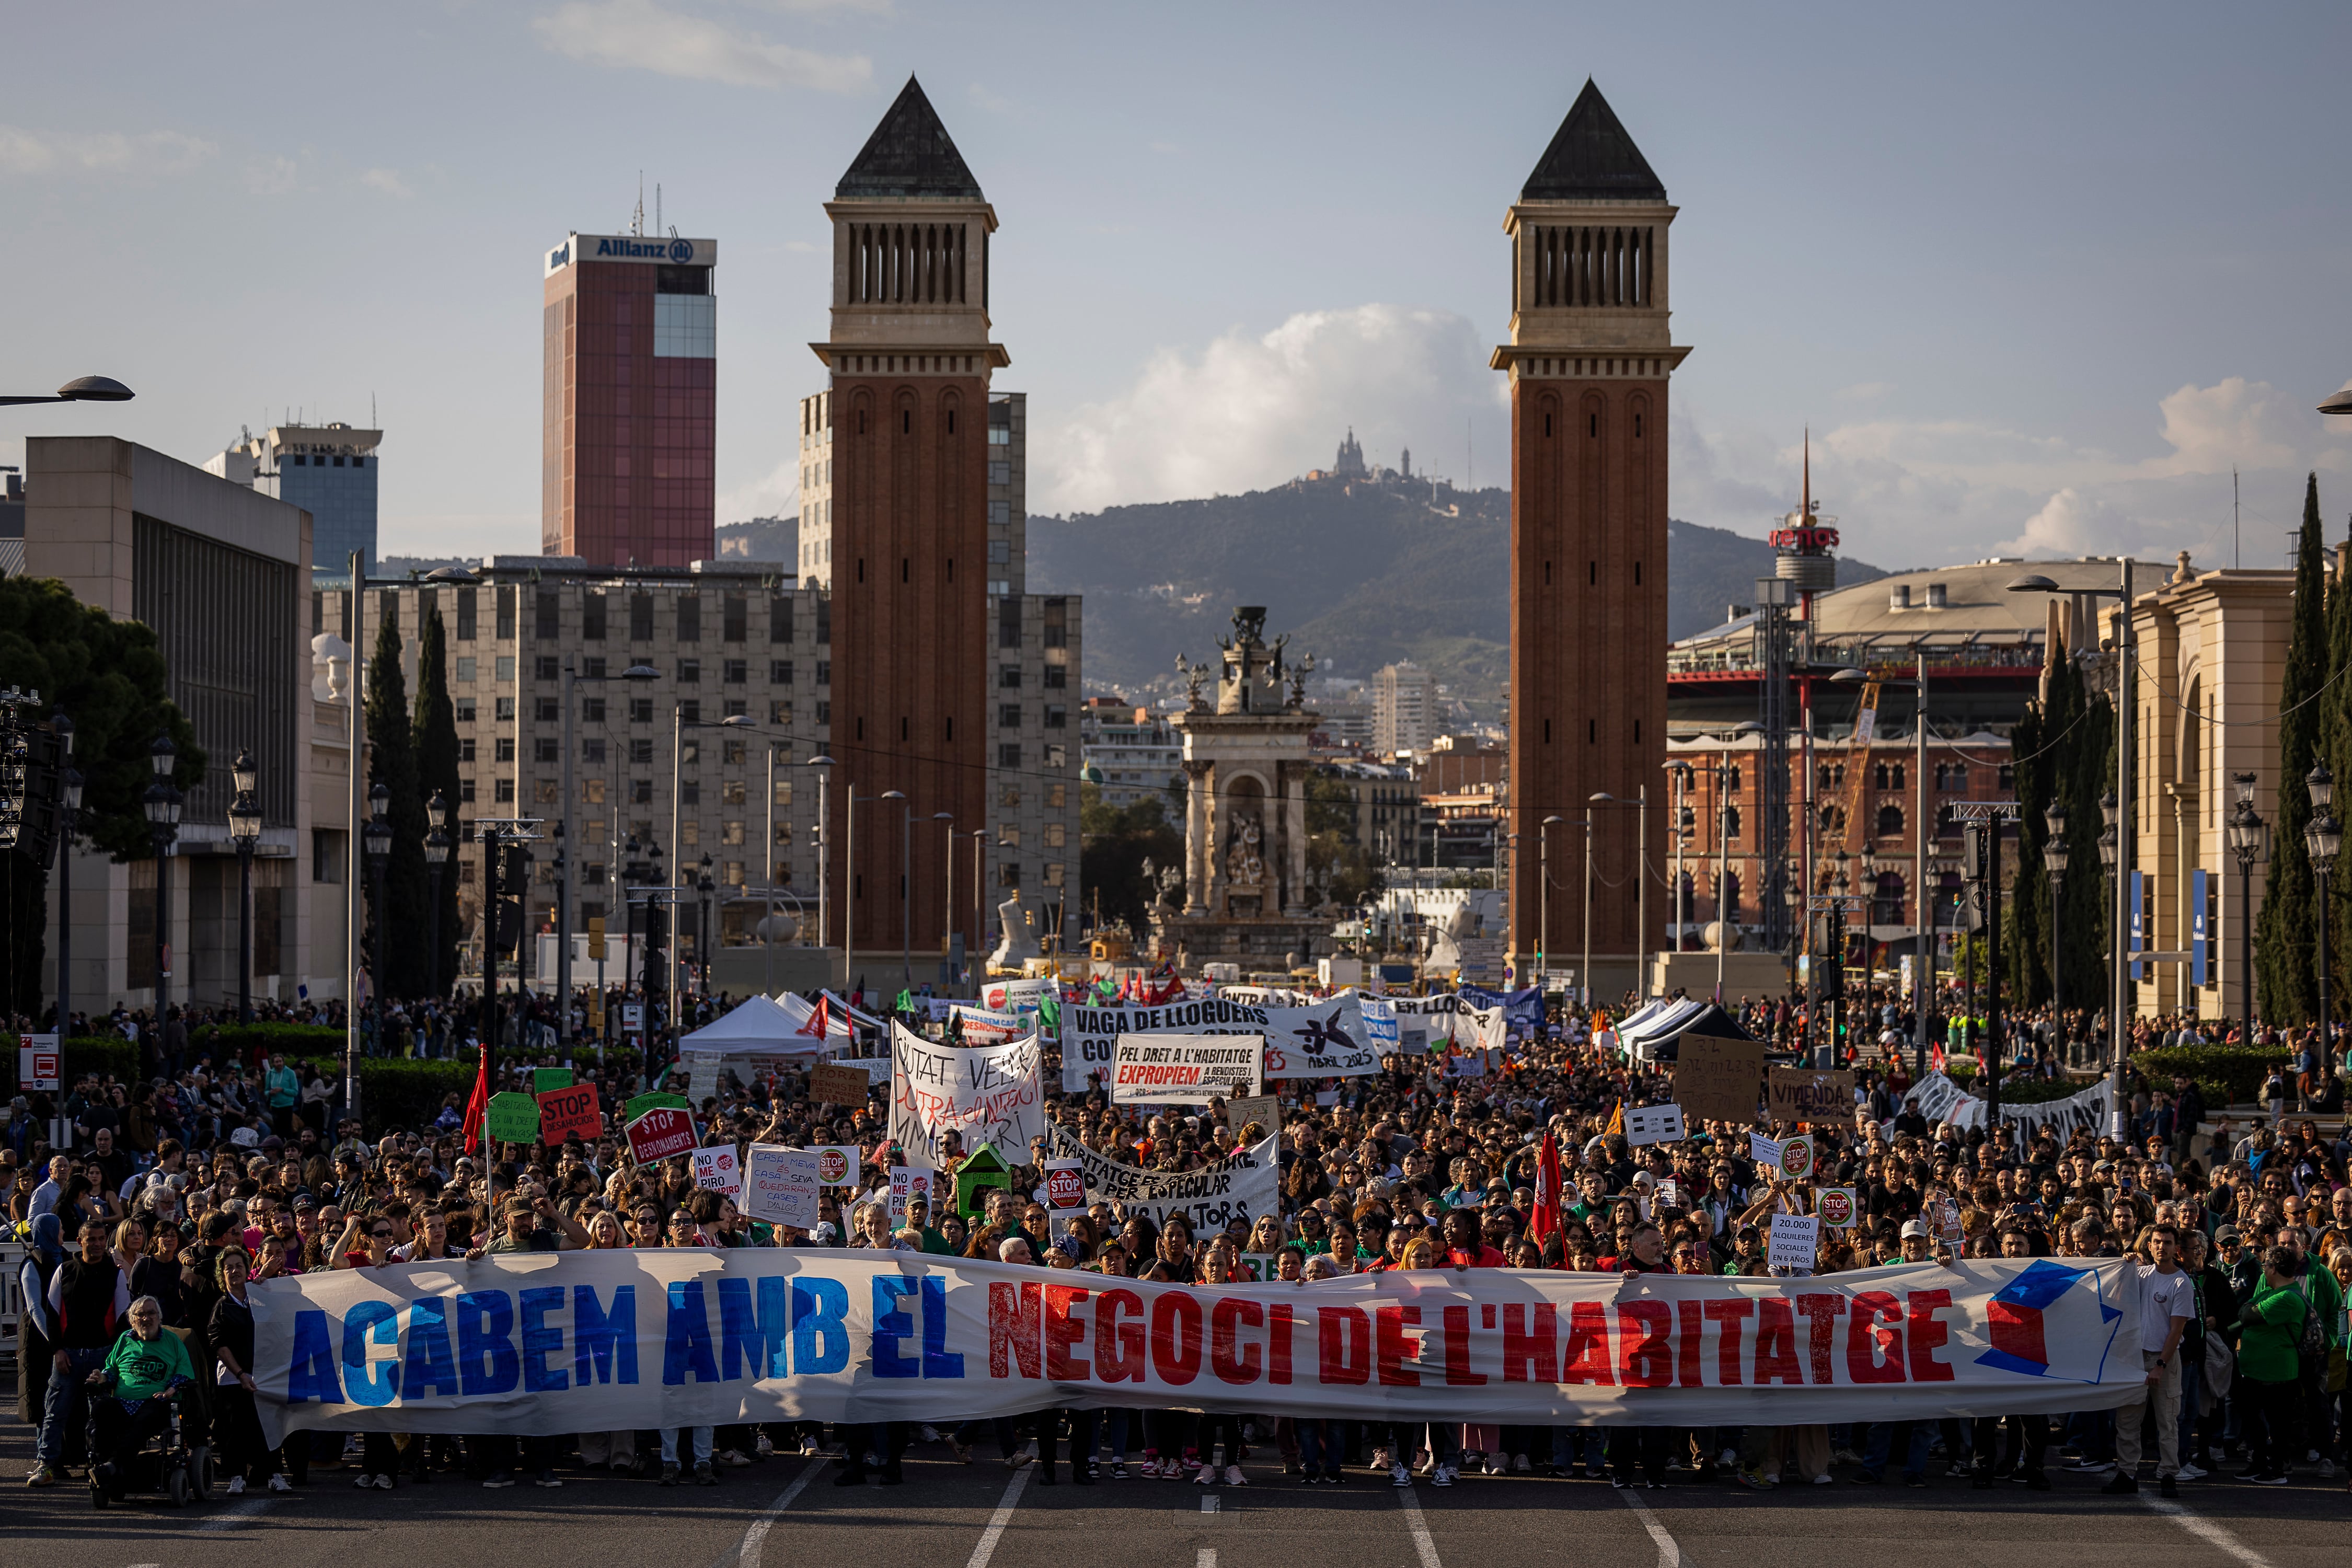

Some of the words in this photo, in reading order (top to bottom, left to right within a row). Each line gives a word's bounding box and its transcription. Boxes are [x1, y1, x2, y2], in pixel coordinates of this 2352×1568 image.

[597, 239, 666, 258] Allianz
[1769, 528, 1840, 548] renas
[1075, 1009, 1130, 1034] VAGA
[1134, 1008, 1161, 1031] DE
[1166, 999, 1270, 1030] LLOGUERS
[1119, 1046, 1139, 1062] PEL
[1143, 1047, 1172, 1063] DRET
[1173, 1048, 1182, 1063] A
[1185, 1048, 1253, 1064] L'HABITATGE
[1343, 1048, 1373, 1068] 2025
[819, 1068, 858, 1081] FORA
[1117, 1065, 1201, 1085] EXPROPIEM
[1204, 1067, 1211, 1076] A
[1211, 1067, 1247, 1076] RENDISTES
[1248, 1067, 1252, 1076] I
[811, 1079, 865, 1094] RENDISTES
[1203, 1076, 1254, 1086] ESPECULADORS
[818, 1093, 858, 1105] BARRIS
[835, 1090, 864, 1101] NOSTRES
[1774, 1083, 1844, 1106] VIVIENDA
[543, 1092, 591, 1121] STOP
[504, 1115, 514, 1124] UN
[516, 1116, 536, 1125] DRET
[547, 1114, 595, 1132] DESAHUCIOS
[642, 1111, 674, 1134] STOP
[637, 1131, 691, 1159] DESNONAMENTS
[697, 1154, 712, 1166] NO
[1786, 1148, 1806, 1160] STOP
[718, 1156, 731, 1166] STOP
[756, 1152, 783, 1163] CASA
[790, 1158, 816, 1169] MEVA
[820, 1157, 844, 1167] STOP
[699, 1166, 714, 1178] ME
[777, 1164, 790, 1174] ÉS
[701, 1176, 725, 1188] PIRO
[791, 1174, 814, 1184] SEVA
[893, 1173, 908, 1183] NO
[973, 1173, 991, 1182] PAH
[893, 1184, 908, 1195] ME
[1051, 1179, 1080, 1193] STOP
[1083, 1172, 1098, 1190] O
[1103, 1183, 1140, 1200] PER
[1148, 1174, 1230, 1200] ESPECULAR
[767, 1192, 798, 1203] CASES
[1052, 1191, 1081, 1199] DESAHUCIOS
[1825, 1199, 1848, 1208] STOP
[1779, 1219, 1811, 1229] 20.000
[1772, 1232, 1814, 1241] ALQUILERES
[1776, 1243, 1808, 1252] SOCIALES
[1789, 1254, 1809, 1263] AÑOS
[287, 1284, 639, 1406] ACABEM
[662, 1276, 850, 1385] AMB
[872, 1275, 965, 1379] EL
[988, 1281, 1294, 1386] NEGOCI
[1318, 1306, 1422, 1387] DE
[1443, 1288, 1956, 1387] L'HABITATGE
